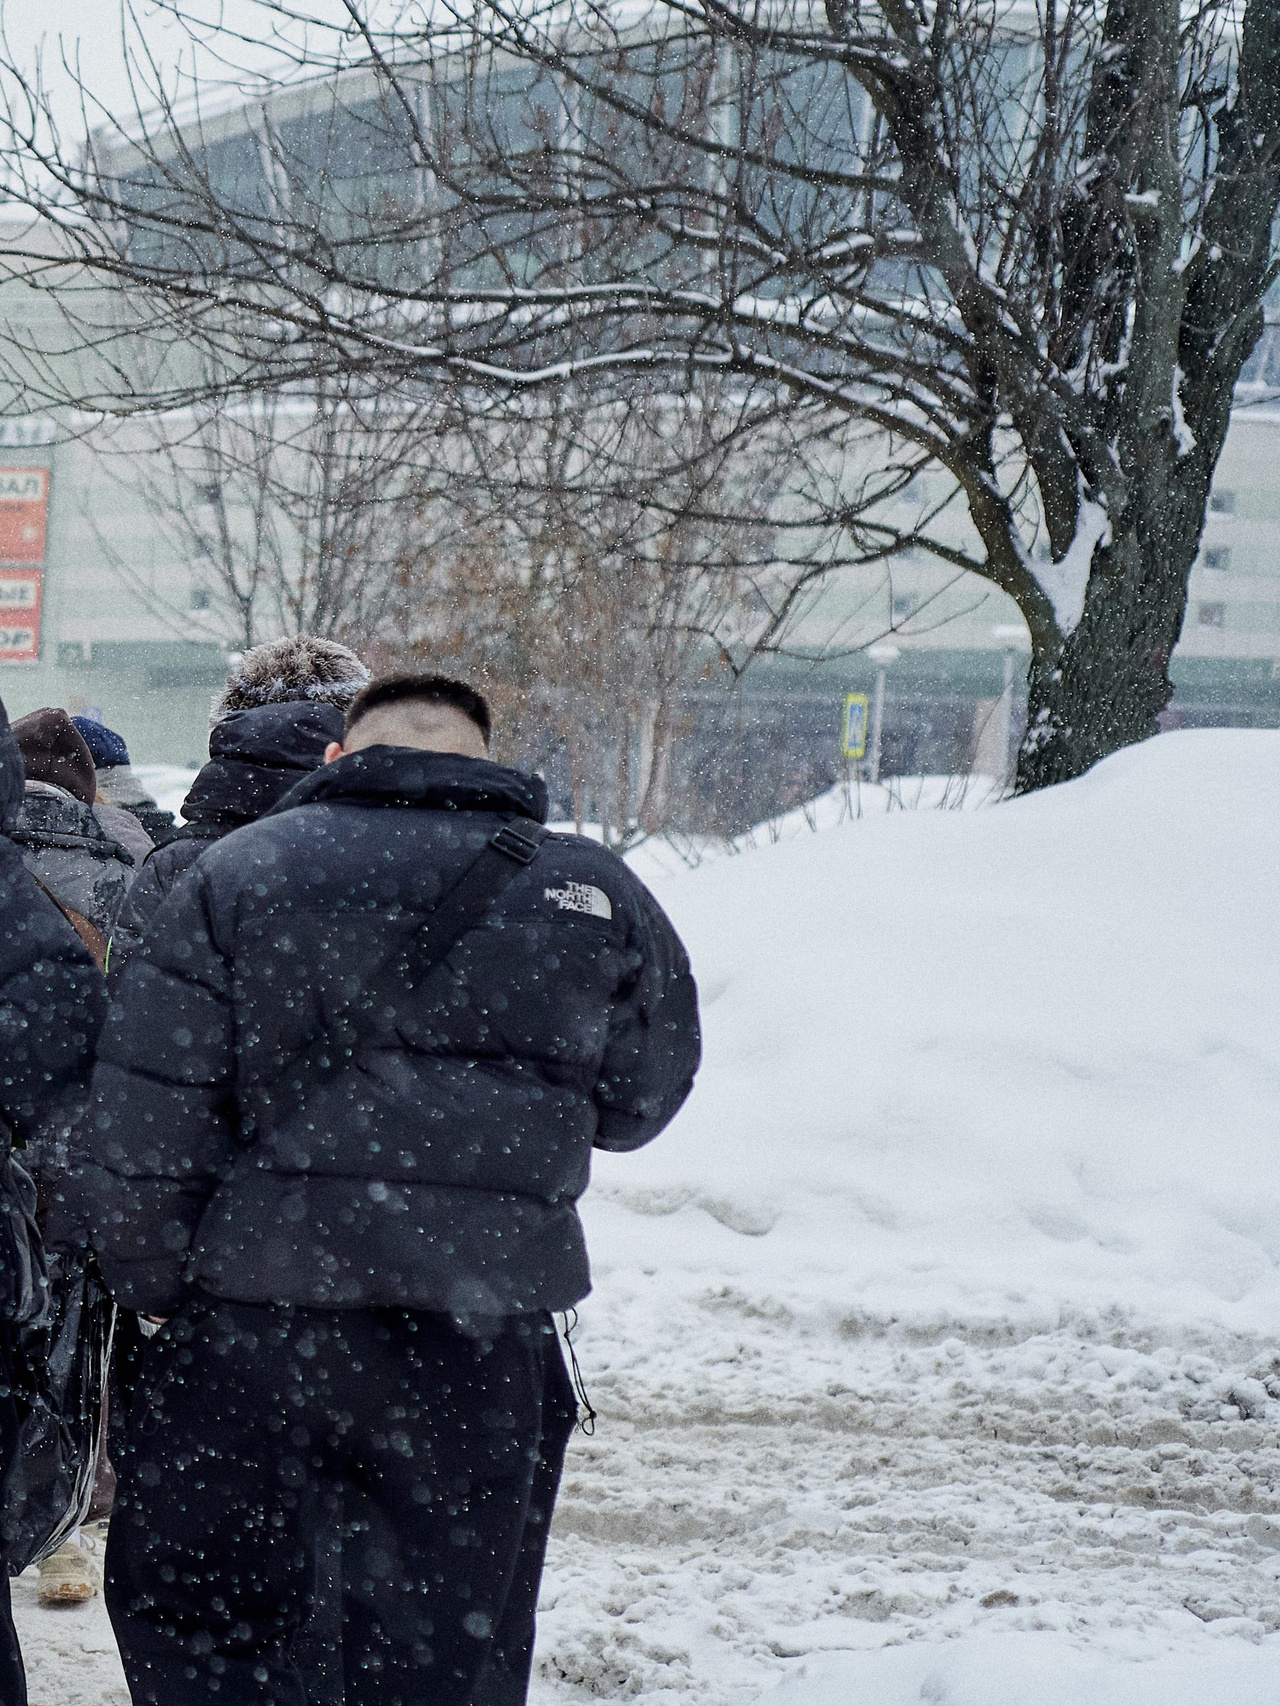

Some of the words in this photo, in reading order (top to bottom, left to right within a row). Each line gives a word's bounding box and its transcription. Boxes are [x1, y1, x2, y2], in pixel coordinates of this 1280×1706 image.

[566, 881, 593, 894] THE
[544, 887, 593, 903] NORTH
[559, 900, 593, 914] FACE
